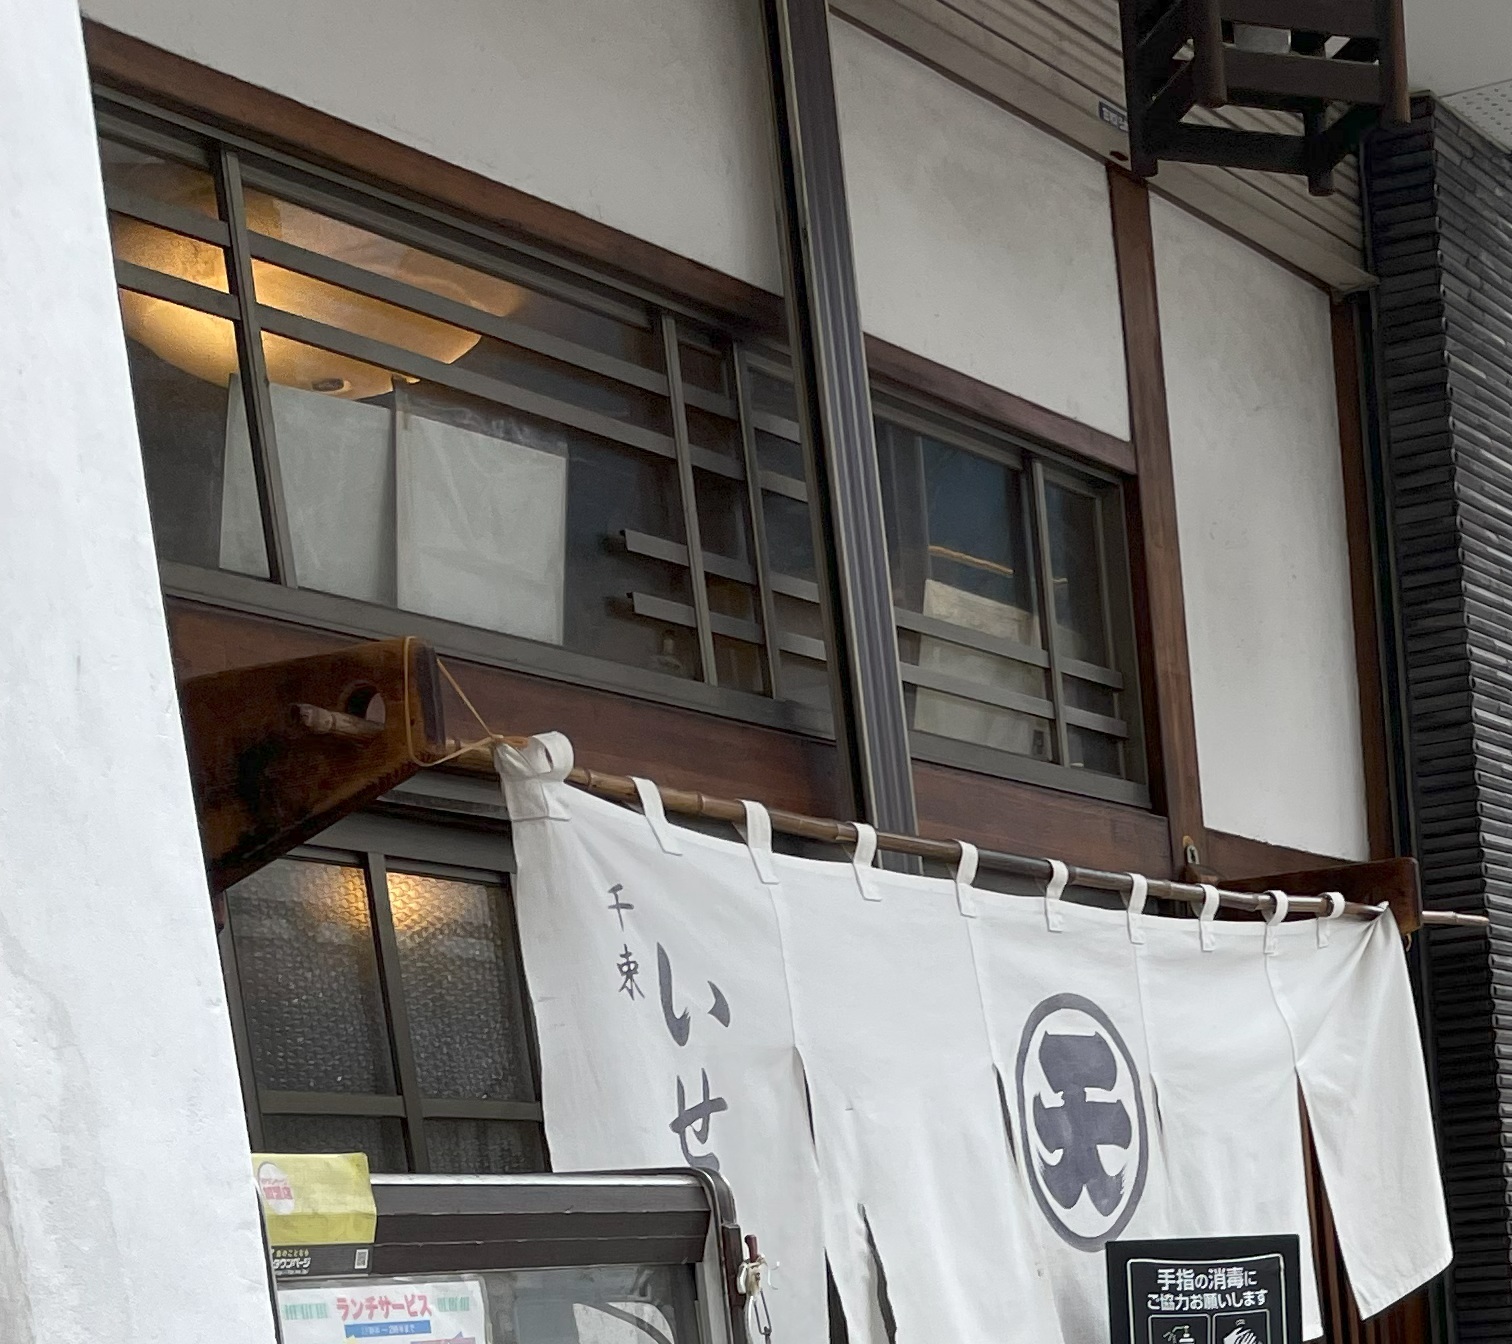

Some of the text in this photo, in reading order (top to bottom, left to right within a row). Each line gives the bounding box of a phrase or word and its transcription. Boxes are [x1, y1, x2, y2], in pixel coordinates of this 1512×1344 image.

[607, 883, 645, 1001] 千束
[1032, 1030, 1133, 1217] 天
[1157, 1267, 1258, 1291] 手指の消毒に
[336, 1294, 433, 1321] ランチサービス
[1147, 1288, 1269, 1311] ご協力お願いします
